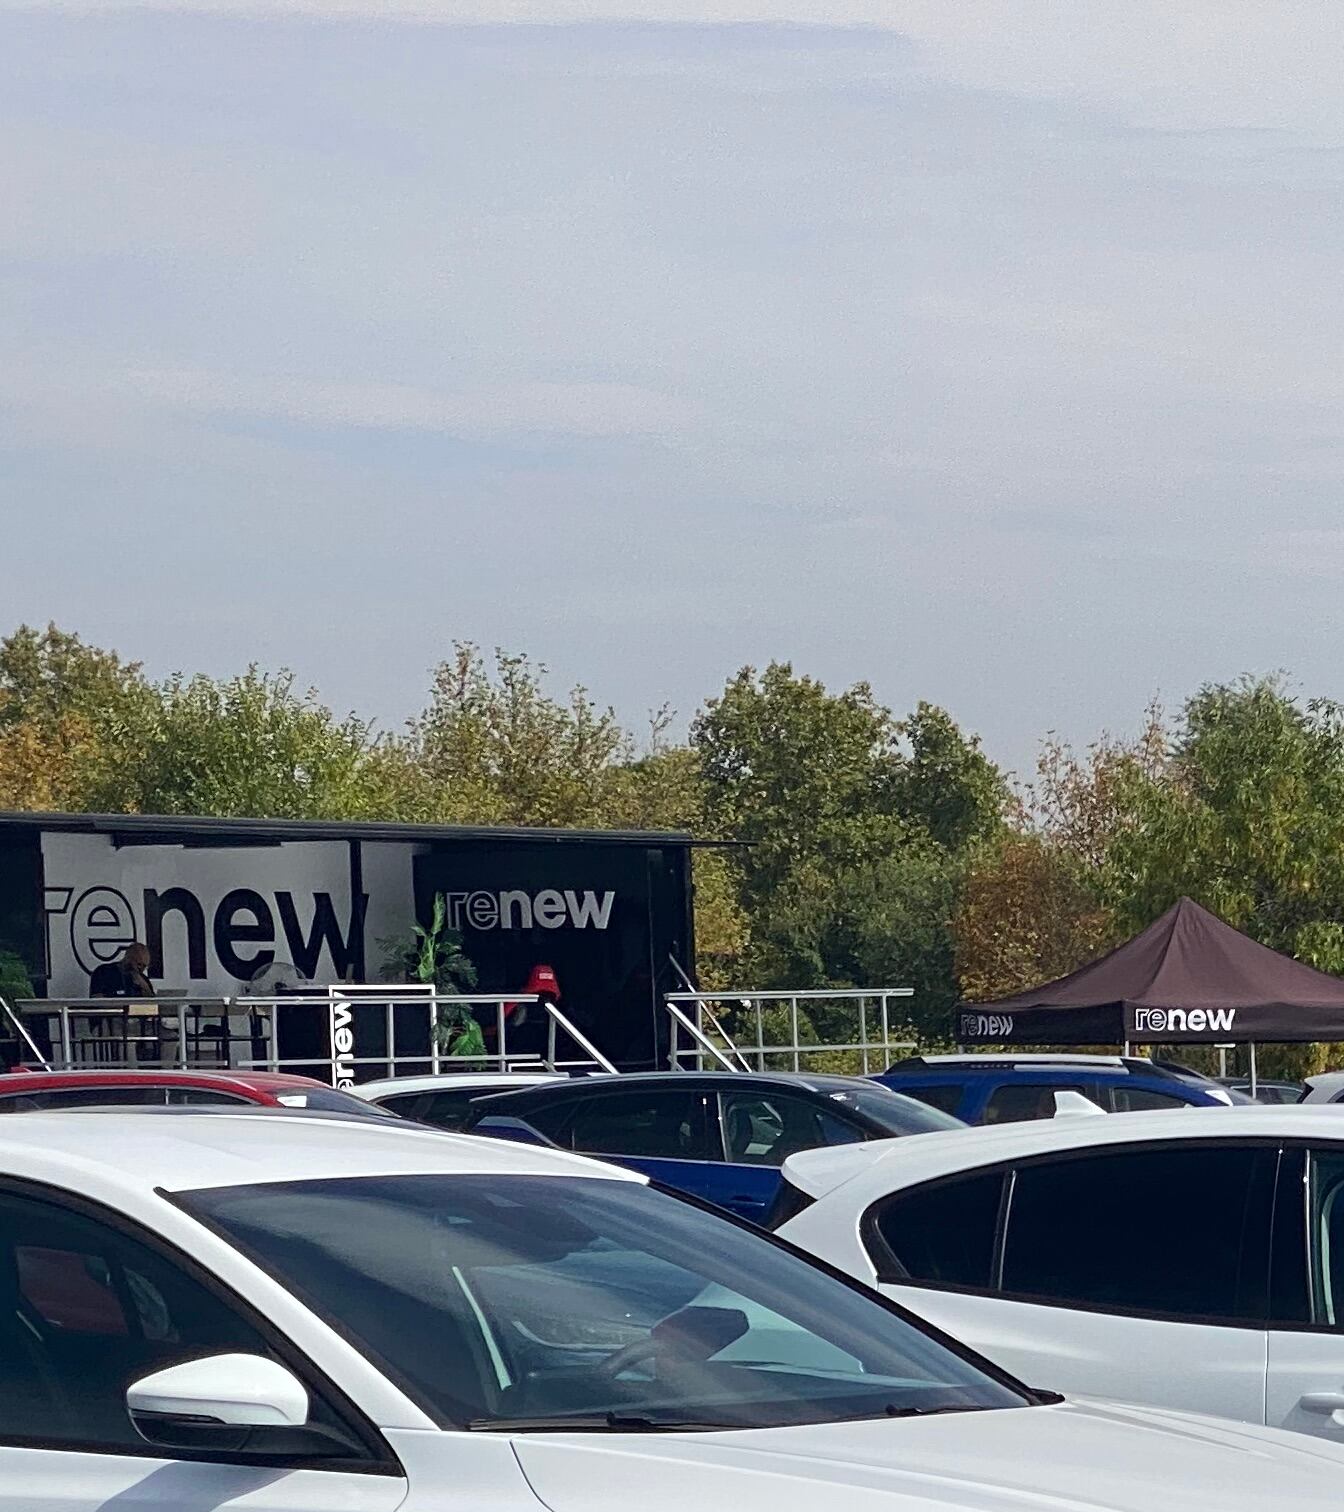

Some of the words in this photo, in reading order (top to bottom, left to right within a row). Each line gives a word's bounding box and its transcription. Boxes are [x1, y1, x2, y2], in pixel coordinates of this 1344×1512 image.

[444, 889, 615, 930] renew
[45, 884, 369, 981] renew
[960, 1013, 1014, 1036] renew
[1134, 1007, 1237, 1032] renew
